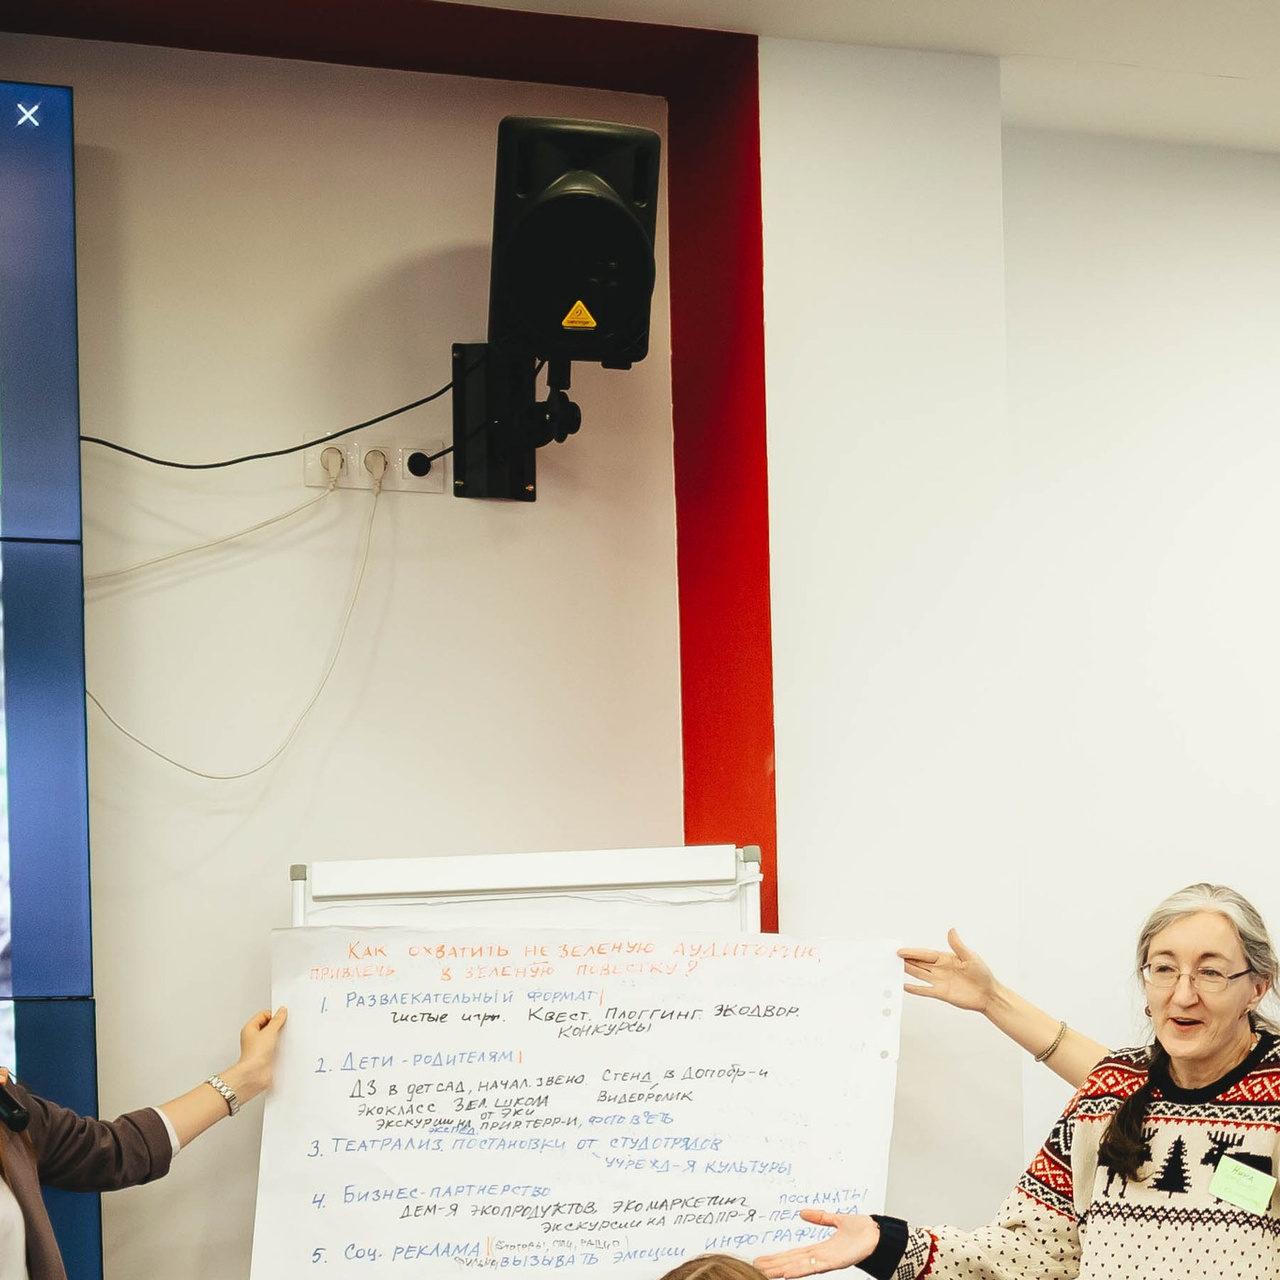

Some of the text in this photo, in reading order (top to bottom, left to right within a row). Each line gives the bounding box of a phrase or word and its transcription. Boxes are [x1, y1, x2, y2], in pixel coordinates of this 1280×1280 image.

[408, 944, 510, 960] ОХВАТИТЬ
[525, 944, 548, 958] НЕ
[558, 942, 655, 958] ЗЕЛЕНУЮ
[310, 965, 396, 980] ПРИВЛЕЧЬ
[440, 966, 453, 982] В
[465, 963, 555, 980] ЗЕЛЕНУЮ
[320, 989, 598, 1014] 1. РАЗВЛЕКАТЕЛЬНЫЙ ФОРМАТ
[558, 1021, 652, 1038] КОНКУРСЫ
[314, 1058, 332, 1073] 2.
[349, 1078, 377, 1099] ДЗ
[357, 1102, 437, 1117] ЭКОКЛАСС
[307, 1139, 323, 1157] 3.
[451, 1137, 567, 1151] ПОСТАНОВКИ
[576, 1138, 599, 1150] ОТ
[704, 1159, 792, 1175] КУЛЬТУРЫ
[311, 1184, 551, 1209] 4. БИЗНЕС-ПАРТНЕРСТВО
[311, 1247, 328, 1263] 5.
[391, 1241, 480, 1261] РЕКЛАМА
[500, 1252, 599, 1268] ВЫЗЫВАТЬ
